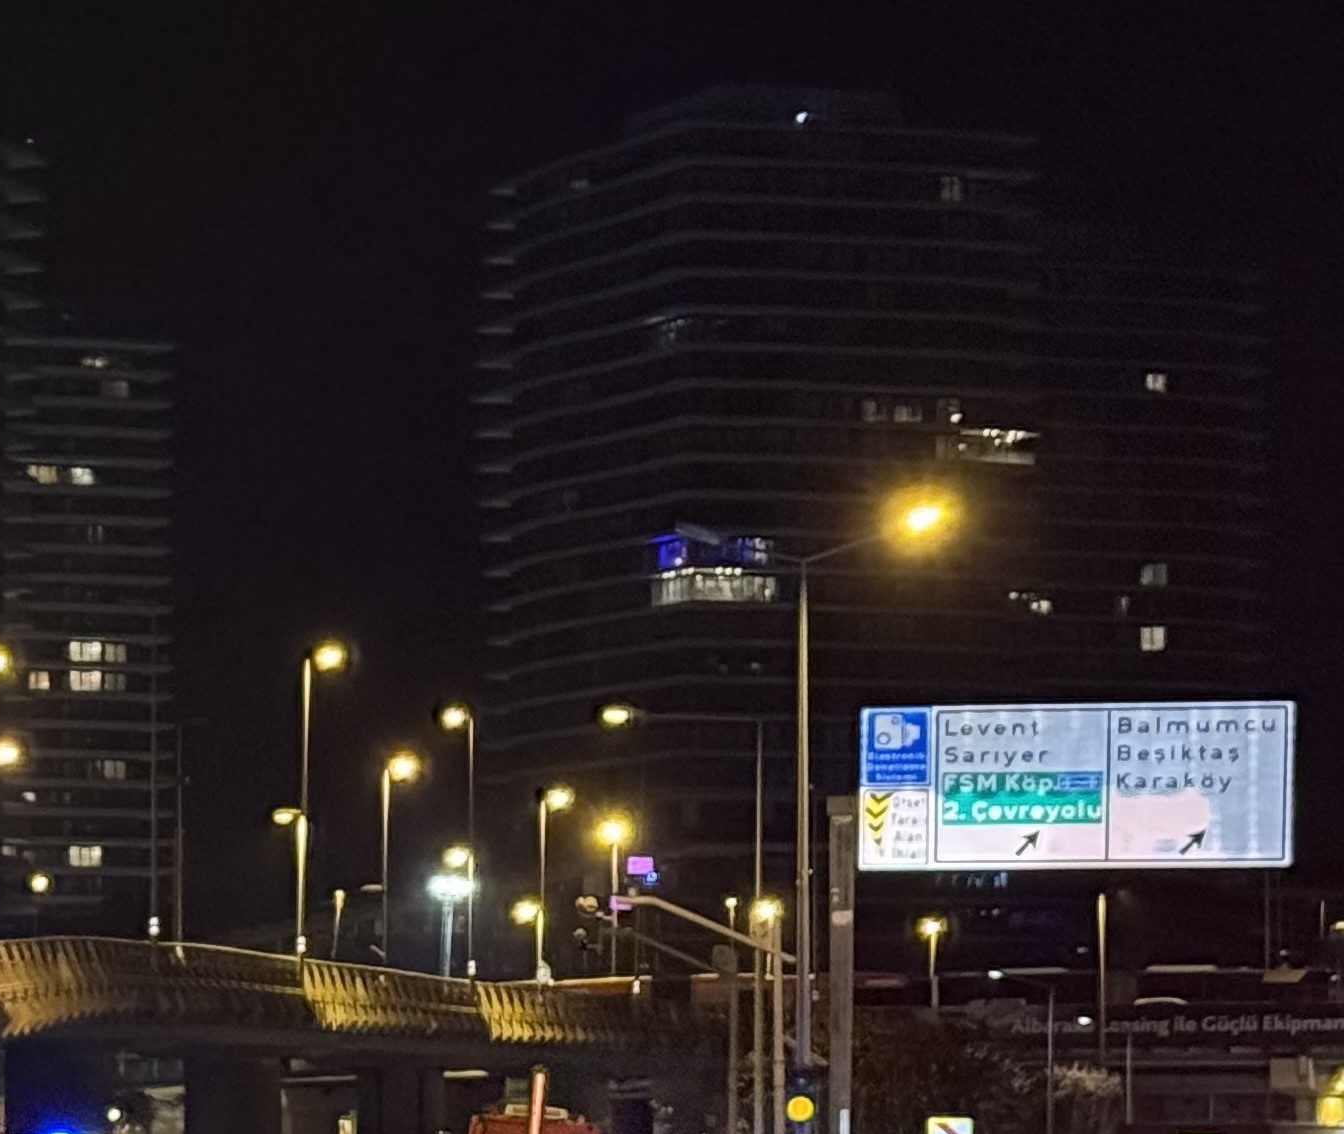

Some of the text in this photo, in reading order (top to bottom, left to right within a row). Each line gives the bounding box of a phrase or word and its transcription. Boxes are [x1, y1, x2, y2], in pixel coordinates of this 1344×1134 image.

[944, 719, 1040, 737] Levent
[1117, 716, 1276, 734] Balmumcu
[944, 746, 1049, 767] Sarıyer
[1117, 744, 1240, 764] Beşiktaş
[943, 773, 998, 792] FSM
[1116, 772, 1232, 793] Karaköy
[943, 801, 1102, 823] 2. Çevreyolu
